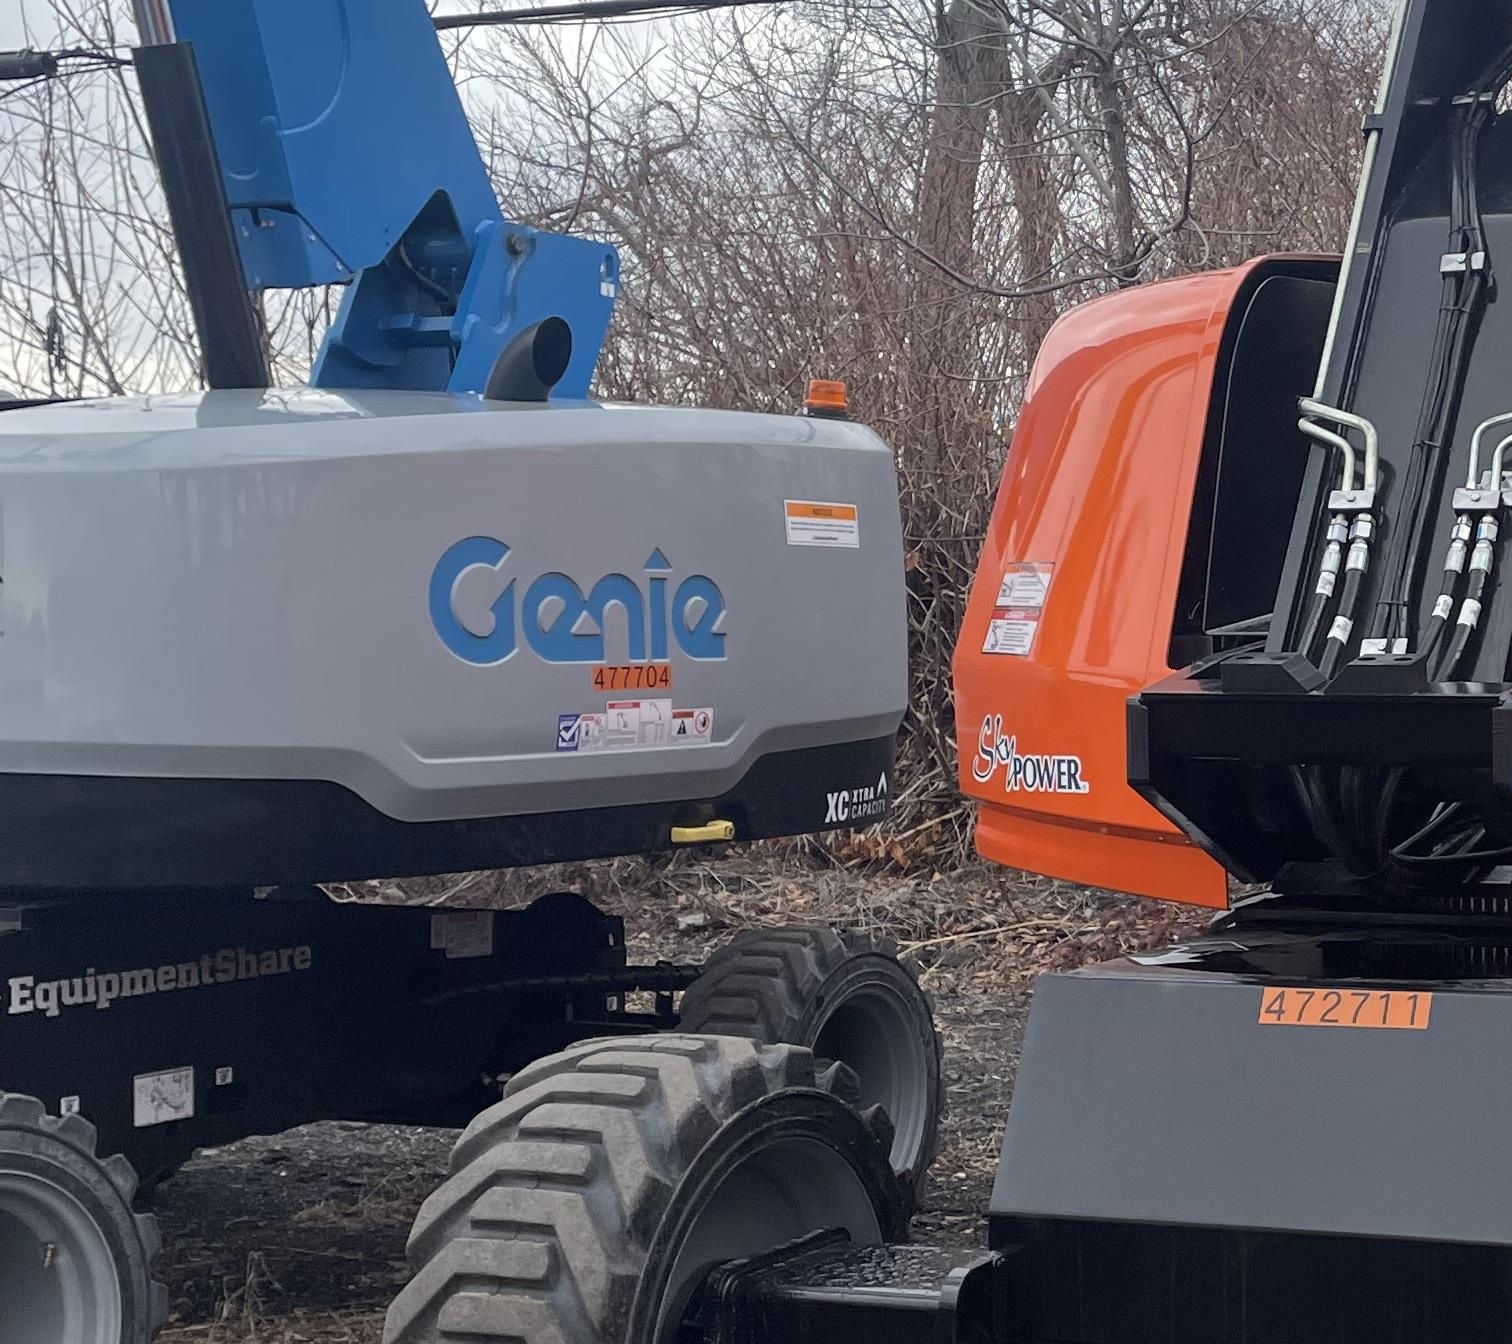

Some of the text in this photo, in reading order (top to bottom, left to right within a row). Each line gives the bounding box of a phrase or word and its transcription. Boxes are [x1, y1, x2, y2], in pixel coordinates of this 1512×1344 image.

[428, 535, 727, 667] Genie
[594, 665, 669, 690] 477704
[825, 790, 849, 823] XC
[853, 787, 874, 803] XTRA
[8, 946, 312, 1017] EquipmentShare
[1264, 990, 1418, 1026] 472711
